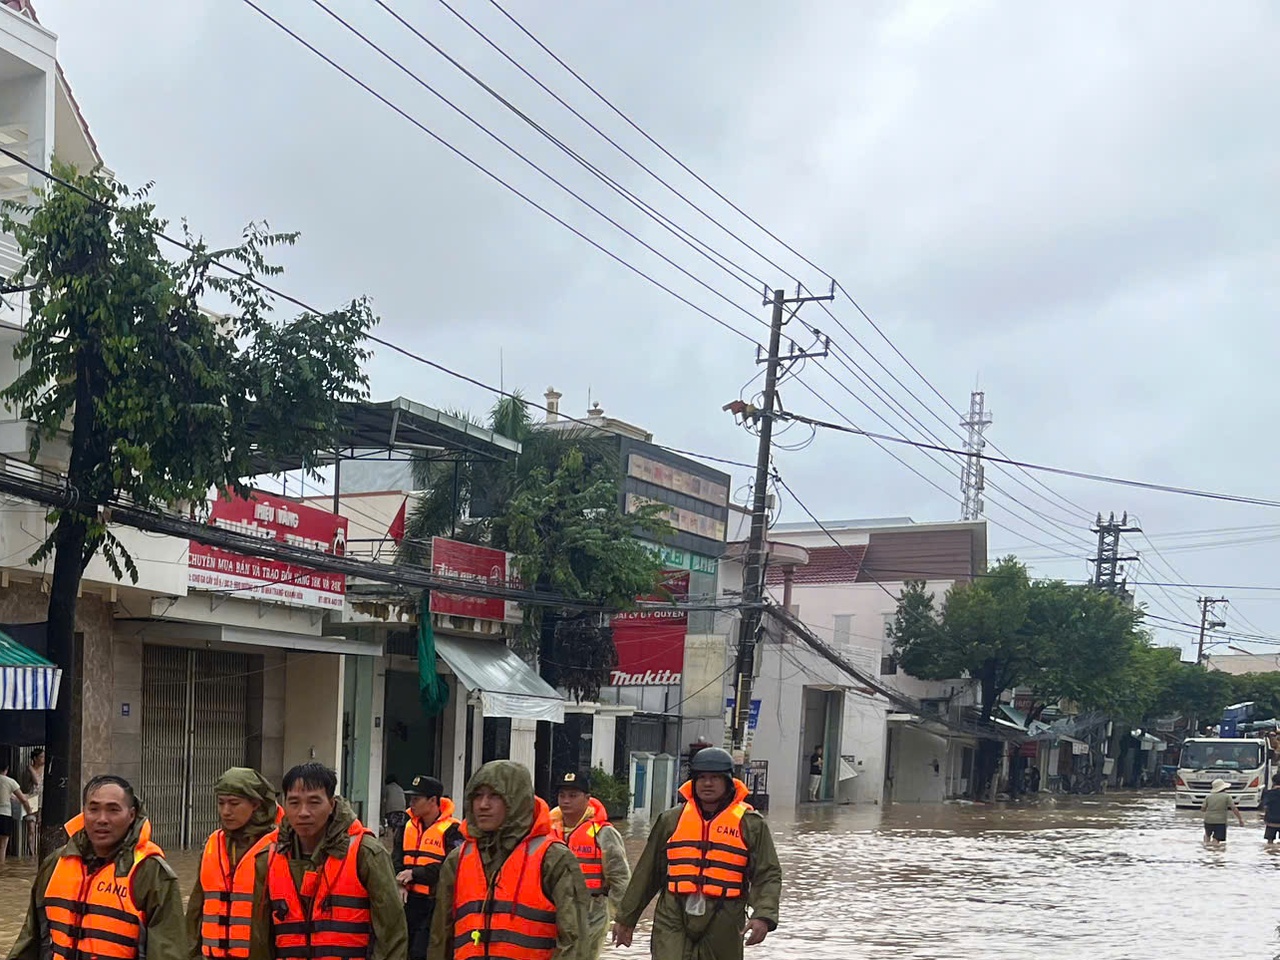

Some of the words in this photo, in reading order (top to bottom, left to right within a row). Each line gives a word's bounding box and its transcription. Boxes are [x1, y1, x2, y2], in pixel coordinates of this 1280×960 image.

[218, 558, 233, 572] MUA
[236, 560, 251, 575] BÁN
[252, 563, 261, 577] VÀ
[262, 566, 279, 580] TRAO
[97, 880, 128, 898] CAND
